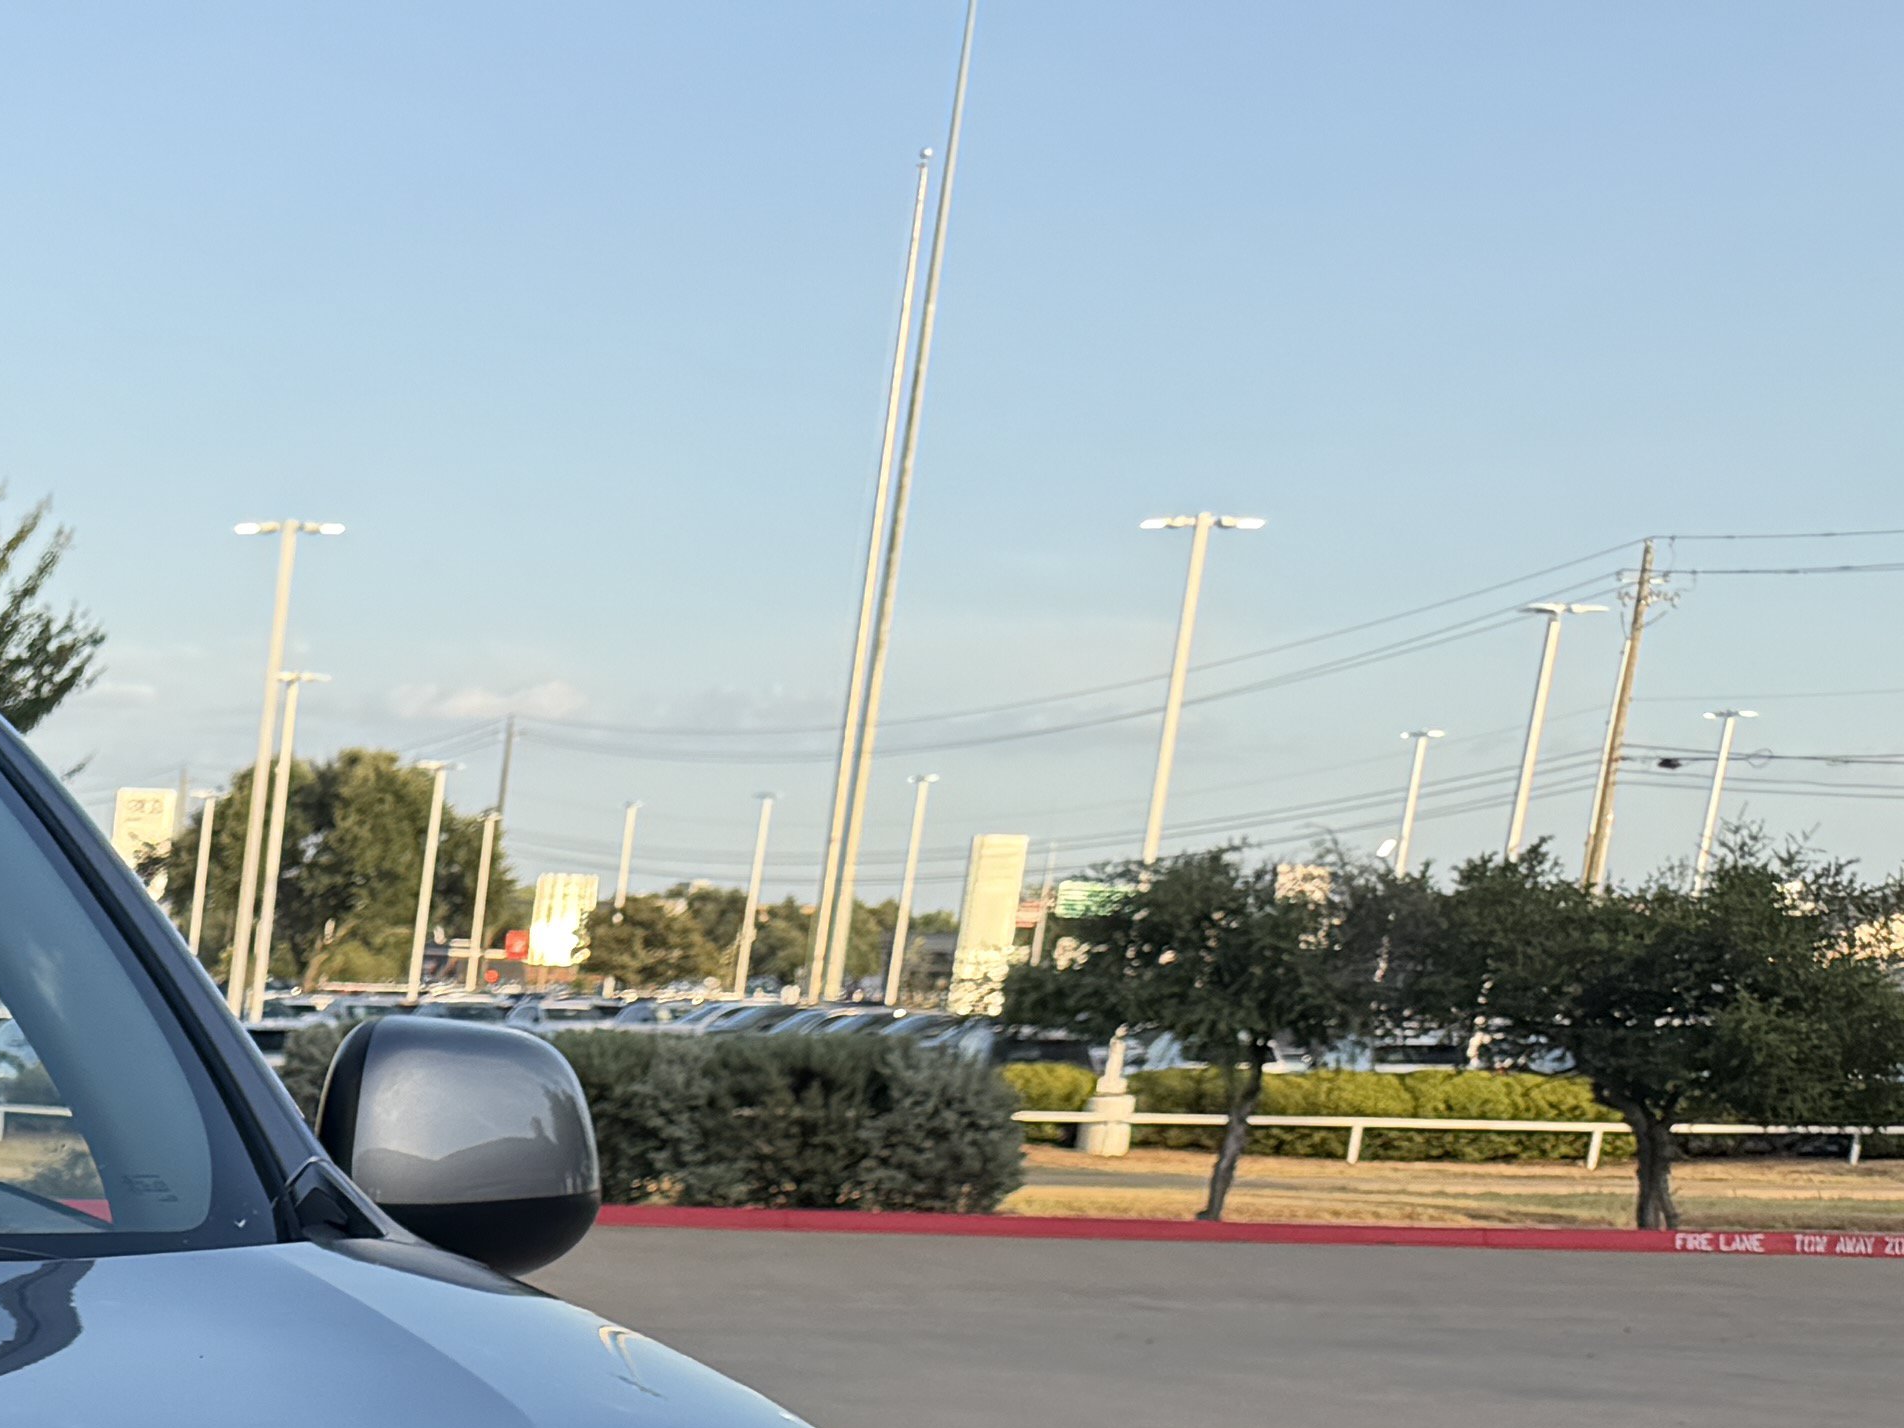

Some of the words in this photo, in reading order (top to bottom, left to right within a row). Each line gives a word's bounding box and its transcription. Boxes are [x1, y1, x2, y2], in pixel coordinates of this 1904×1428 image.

[1675, 1233, 1713, 1251] FIRE
[1719, 1233, 1765, 1253] LANE
[1794, 1234, 1827, 1253] TOW
[1835, 1236, 1875, 1254] AWAY
